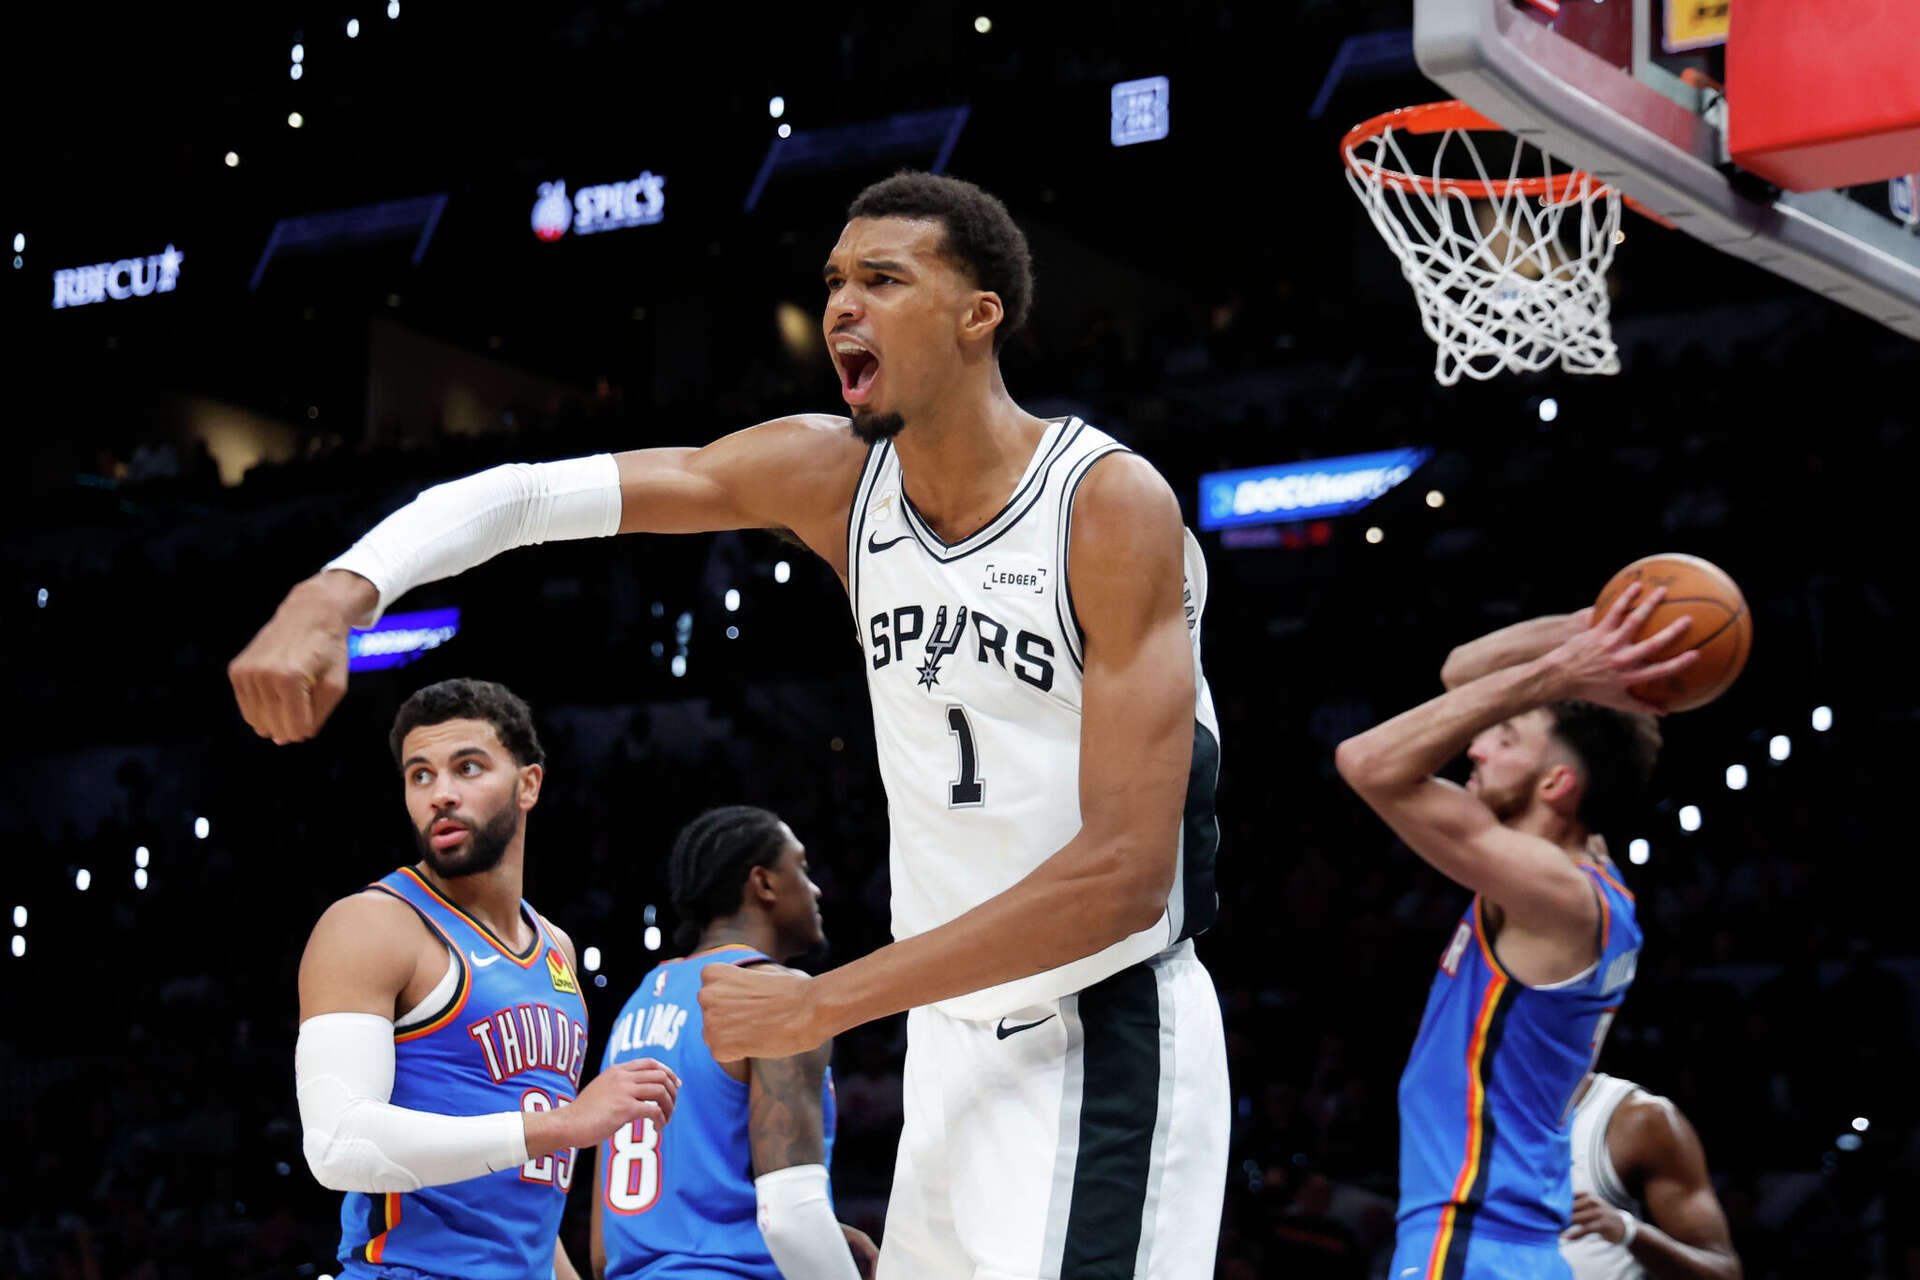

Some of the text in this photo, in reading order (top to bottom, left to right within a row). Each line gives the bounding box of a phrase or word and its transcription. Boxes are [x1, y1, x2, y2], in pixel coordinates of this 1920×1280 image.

[992, 572, 1037, 586] LEDGER
[870, 605, 1055, 693] SPURS
[945, 704, 986, 810] 1
[467, 1003, 588, 1084] THUNDE
[606, 1101, 663, 1216] 8
